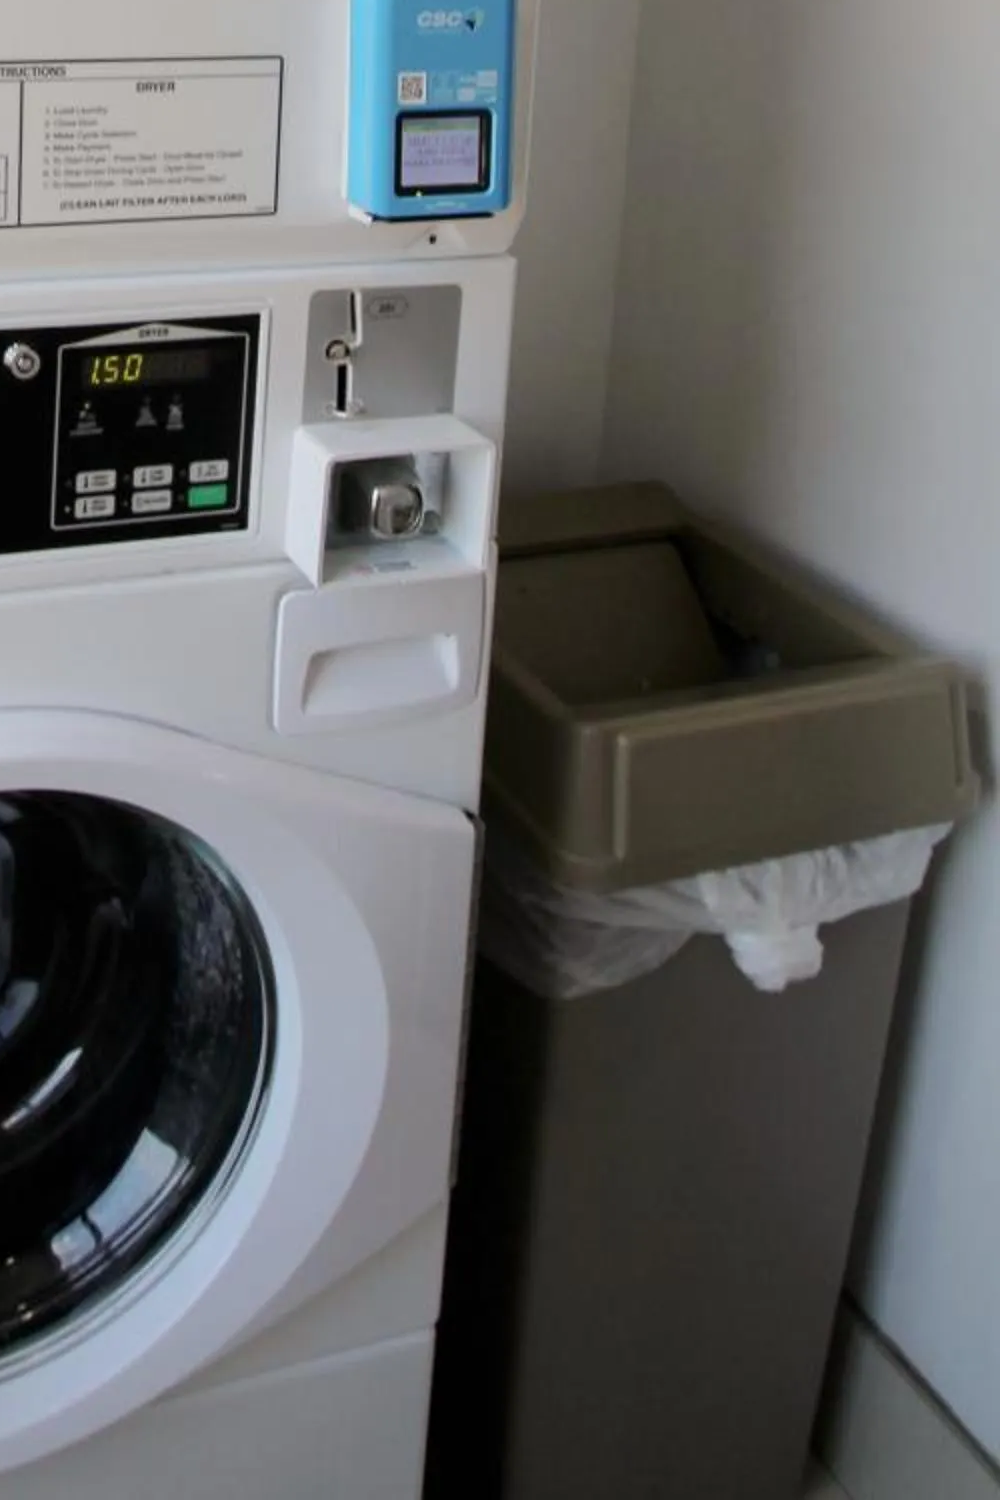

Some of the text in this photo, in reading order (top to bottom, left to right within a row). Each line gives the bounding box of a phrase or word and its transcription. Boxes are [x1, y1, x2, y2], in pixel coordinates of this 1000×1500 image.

[417, 11, 462, 28] CSC
[136, 81, 176, 93] DRYER
[138, 328, 169, 339] DRYER
[91, 354, 143, 385] 1.50
